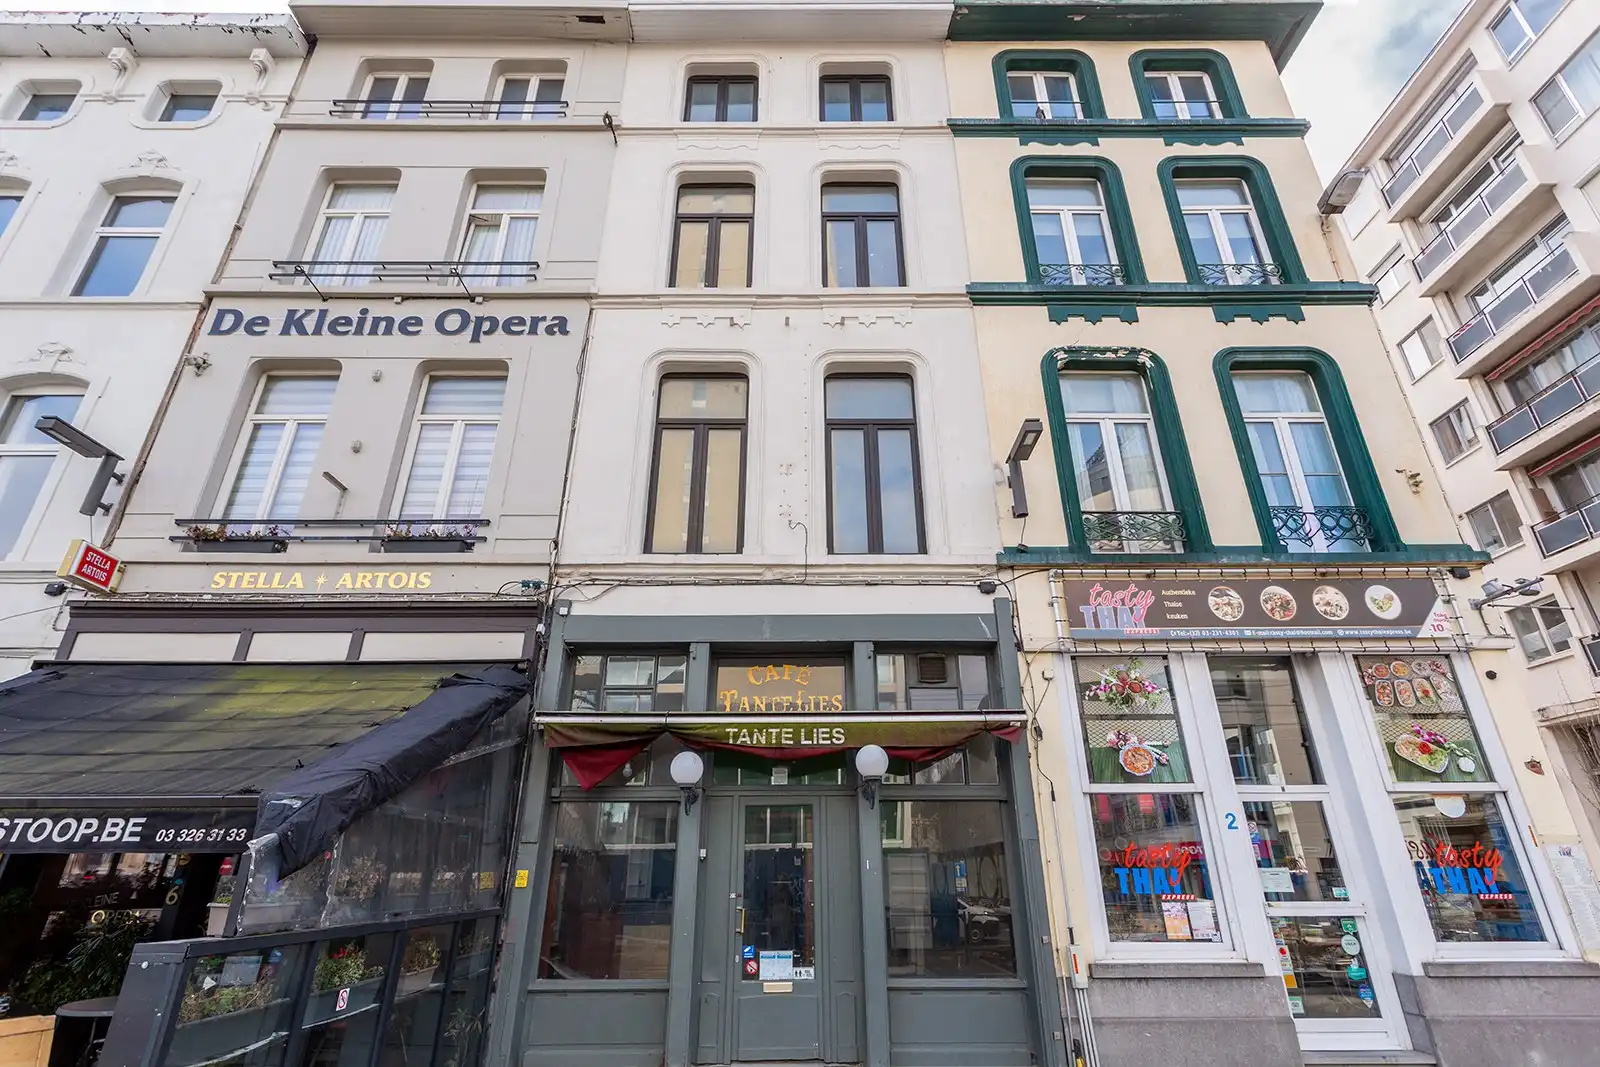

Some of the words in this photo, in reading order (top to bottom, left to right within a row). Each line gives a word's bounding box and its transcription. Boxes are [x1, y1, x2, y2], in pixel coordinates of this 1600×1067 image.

[208, 307, 270, 336] De
[278, 307, 423, 336] Kleine
[434, 307, 571, 343] Opera
[86, 552, 111, 570] STELLA
[81, 564, 108, 582] ARTOIS
[211, 572, 303, 589] STELLA
[335, 572, 432, 590] ARTOIS
[1089, 583, 1155, 622] tasty
[1079, 606, 1146, 629] THAI
[1165, 612, 1188, 620] keuken
[725, 728, 793, 744] TANTE
[800, 728, 845, 744] LIES
[1225, 813, 1239, 830] 2
[155, 829, 175, 842] 03
[177, 828, 206, 842] 326
[206, 828, 224, 841] 31
[226, 828, 247, 841] 33
[1124, 841, 1192, 886] tasty
[1435, 841, 1503, 885] tasty
[1114, 868, 1182, 894] THAI
[1429, 867, 1500, 894] THAI
[165, 885, 179, 905] 6
